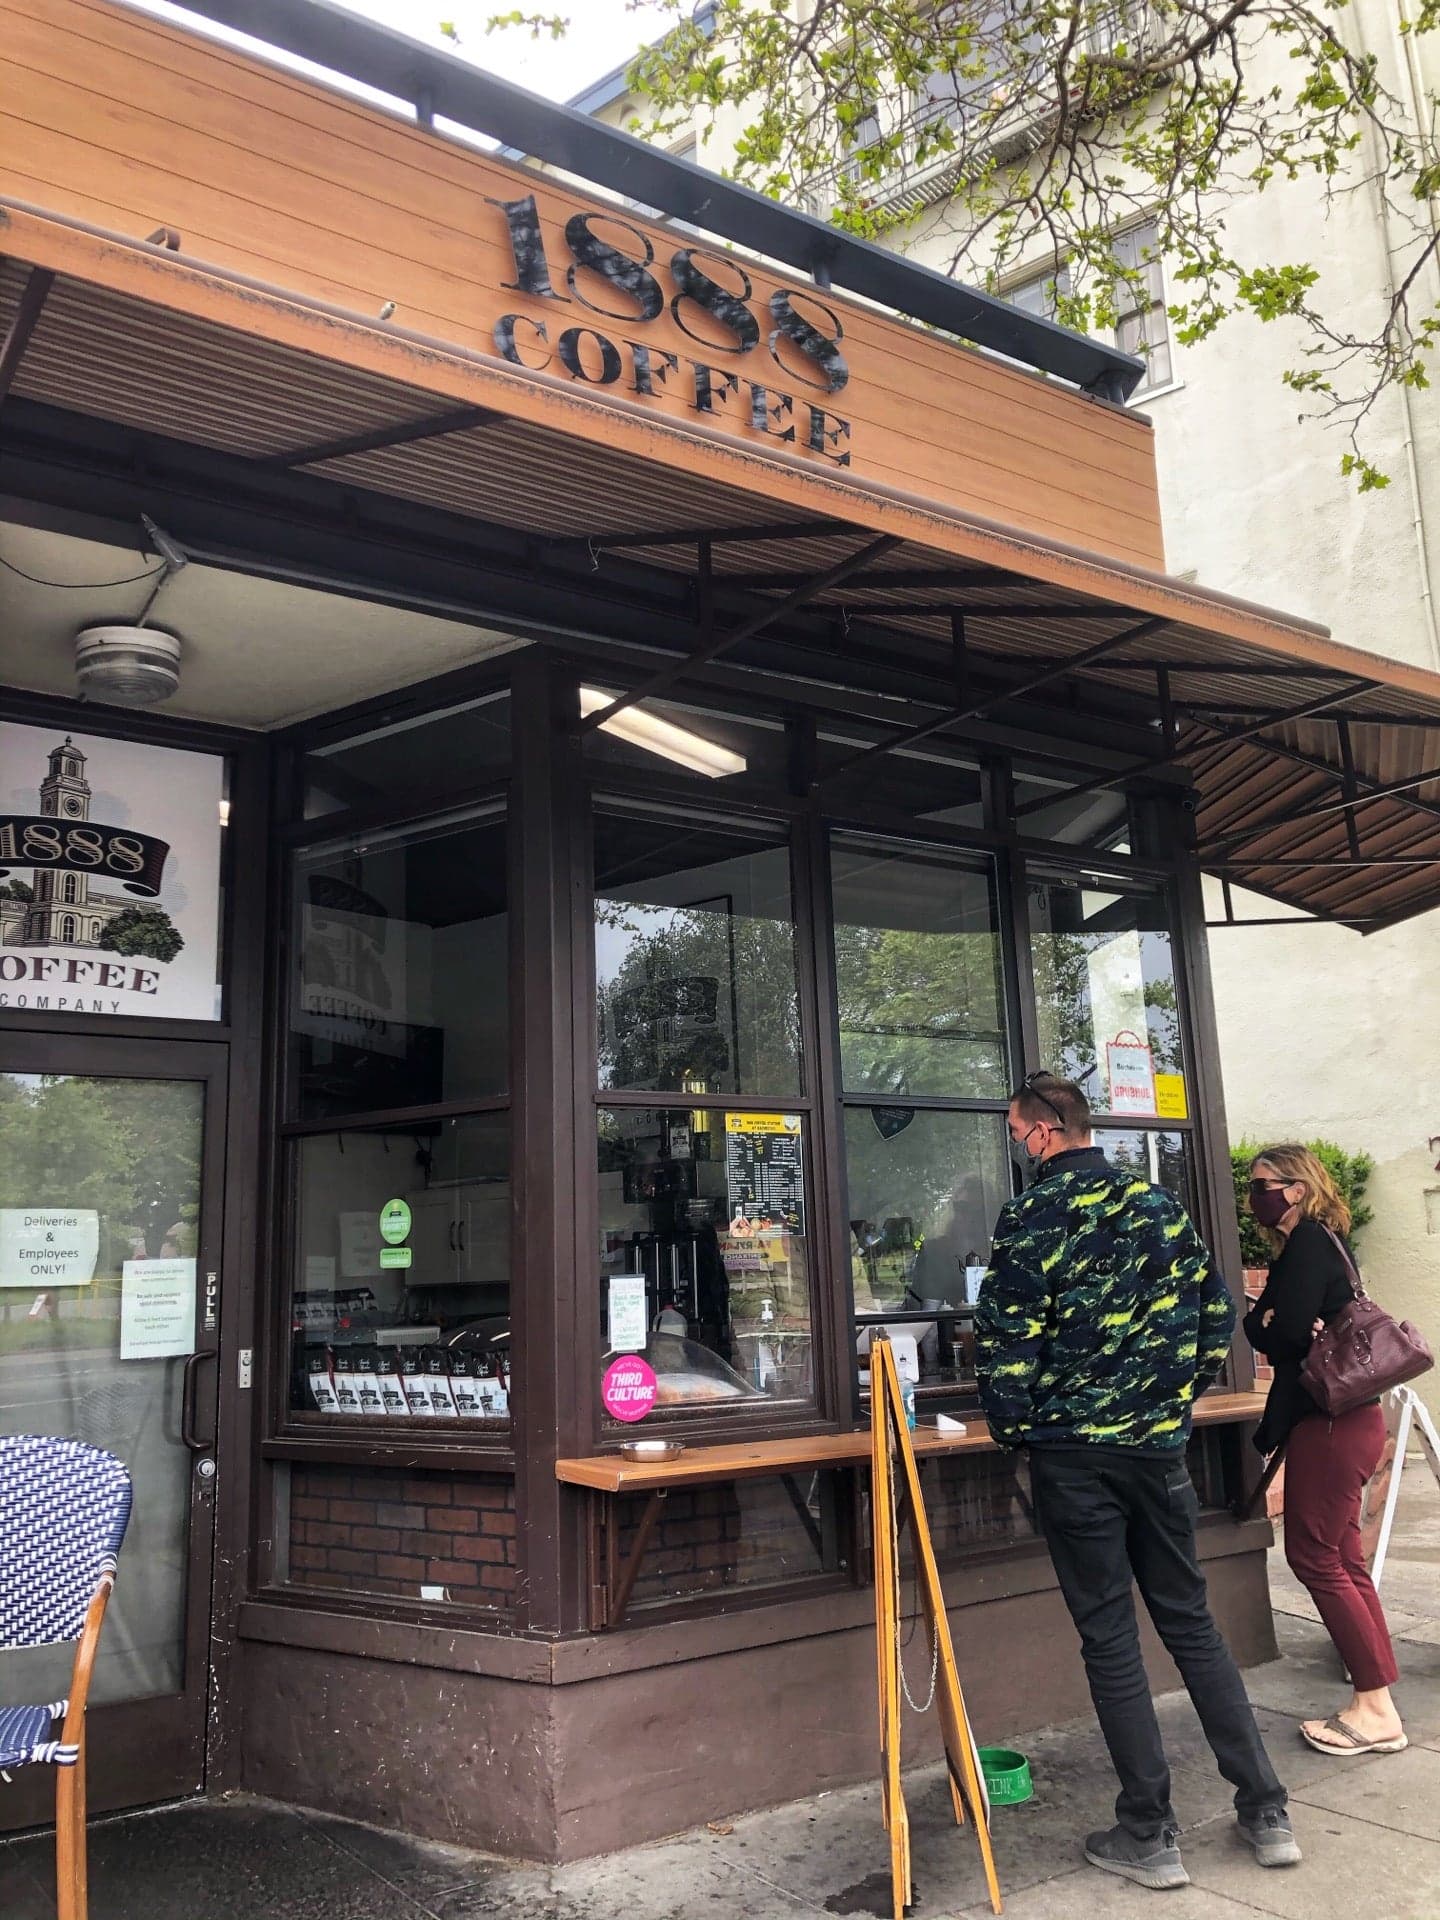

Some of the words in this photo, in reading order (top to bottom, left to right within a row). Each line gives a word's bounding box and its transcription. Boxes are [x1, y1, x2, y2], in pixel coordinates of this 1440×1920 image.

[483, 194, 849, 395] 1888
[493, 314, 851, 467] COFFEE
[0, 823, 145, 873] 1888
[0, 955, 160, 995] OFFEE
[0, 993, 121, 1013] COMPANY
[24, 1216, 78, 1227] Deliveries
[45, 1232, 55, 1242] &
[19, 1249, 79, 1260] Employees
[30, 1264, 66, 1275] ONLY!
[206, 1275, 217, 1317] PULL
[610, 1372, 643, 1387] THIRD
[607, 1386, 656, 1401] CULTURE
